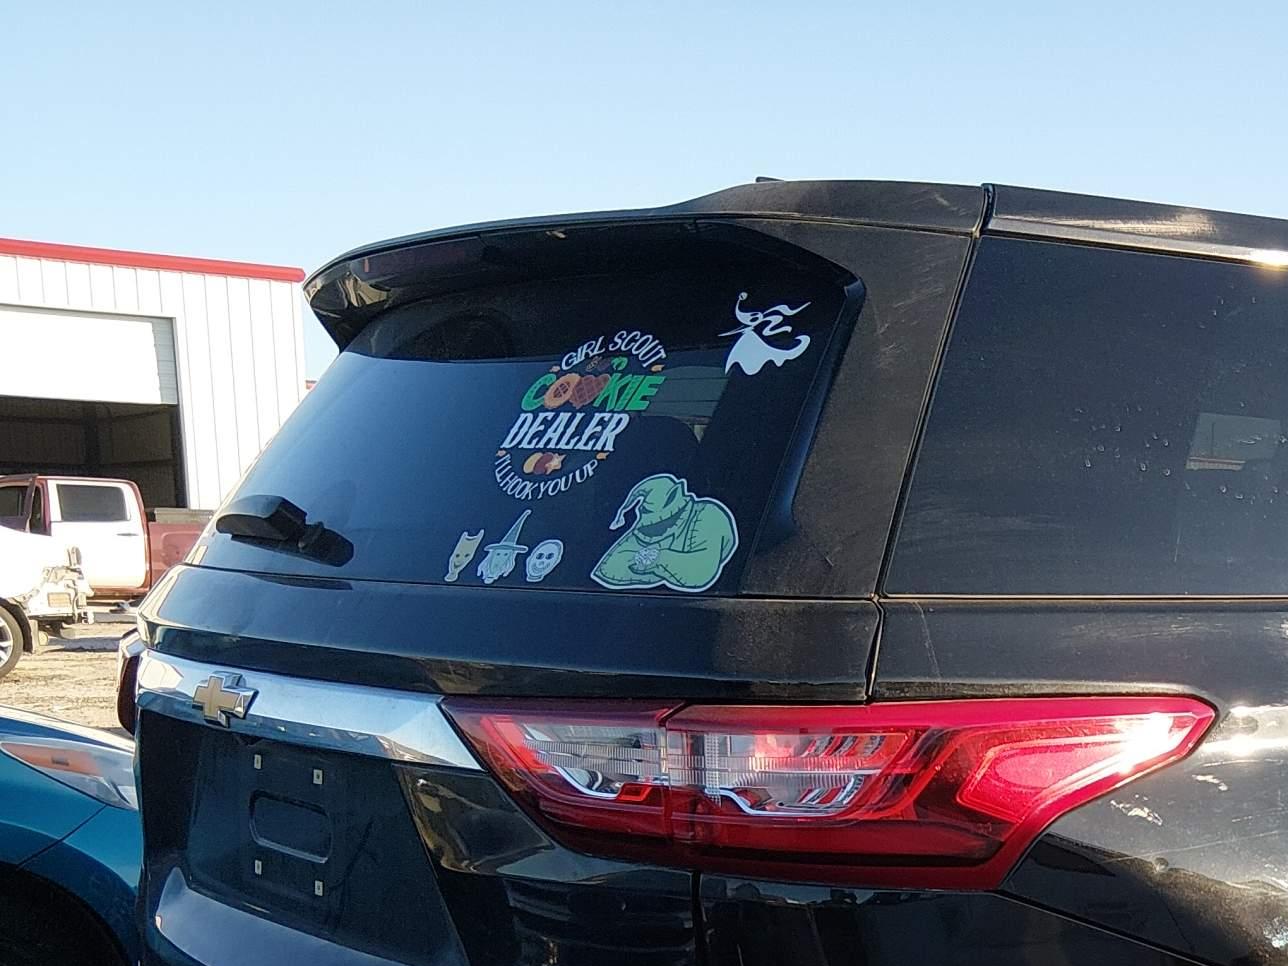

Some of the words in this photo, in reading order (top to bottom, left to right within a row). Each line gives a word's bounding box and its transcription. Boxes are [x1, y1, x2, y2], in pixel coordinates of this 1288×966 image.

[561, 335, 606, 371] GIRL
[608, 330, 667, 368] SCOUT
[521, 373, 667, 411] COOKIE
[500, 412, 630, 452] DEALER
[500, 471, 539, 500] HOOK
[537, 472, 574, 500] YOU
[575, 459, 599, 483] UP
